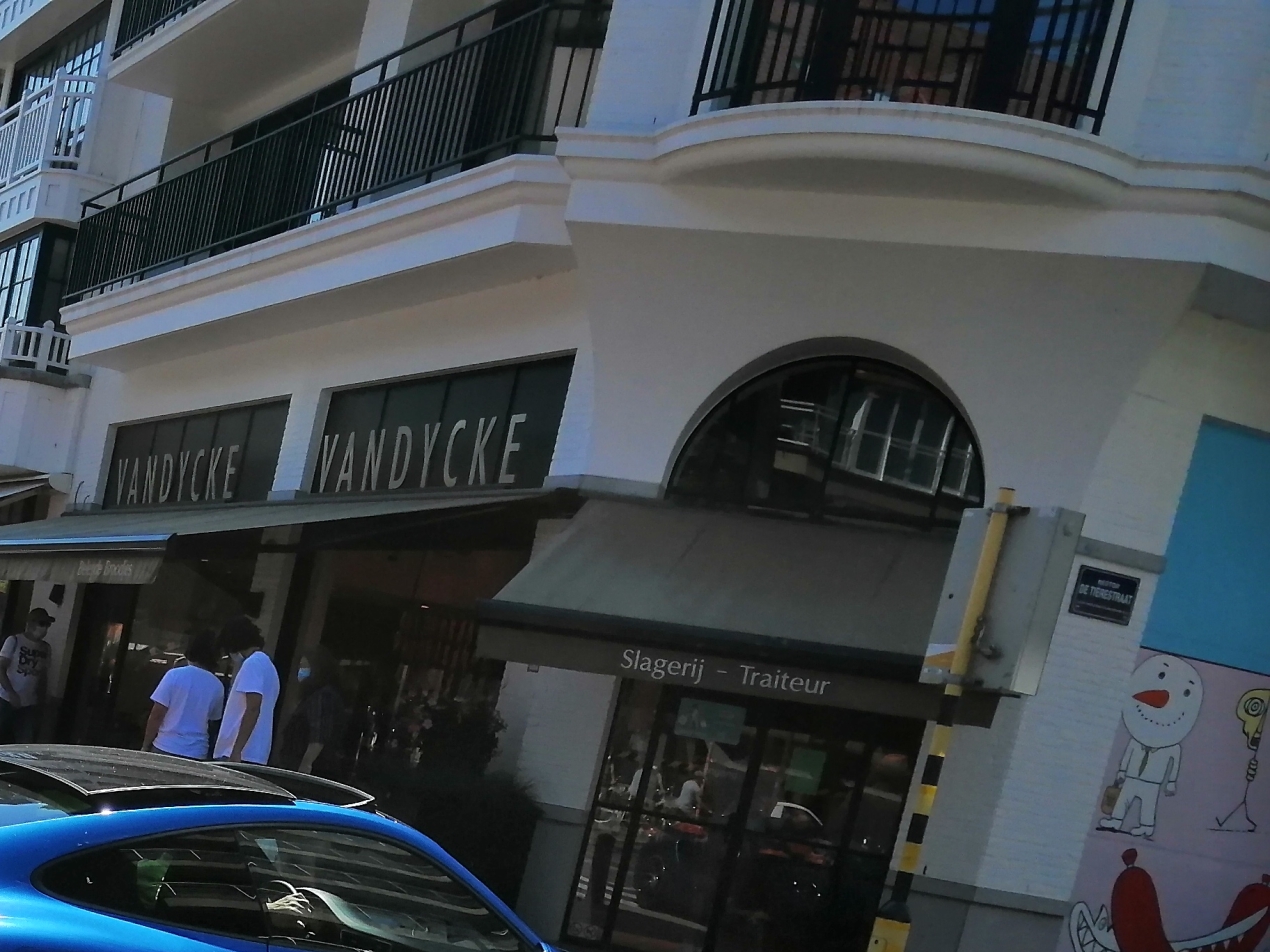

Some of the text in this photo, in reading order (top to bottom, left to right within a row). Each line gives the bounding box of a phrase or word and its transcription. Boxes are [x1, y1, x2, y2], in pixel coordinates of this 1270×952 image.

[117, 444, 239, 506] VANDYCKE
[319, 412, 527, 494] VANDYCKE
[620, 649, 705, 685] Slagerij
[740, 664, 831, 695] Traiteur
